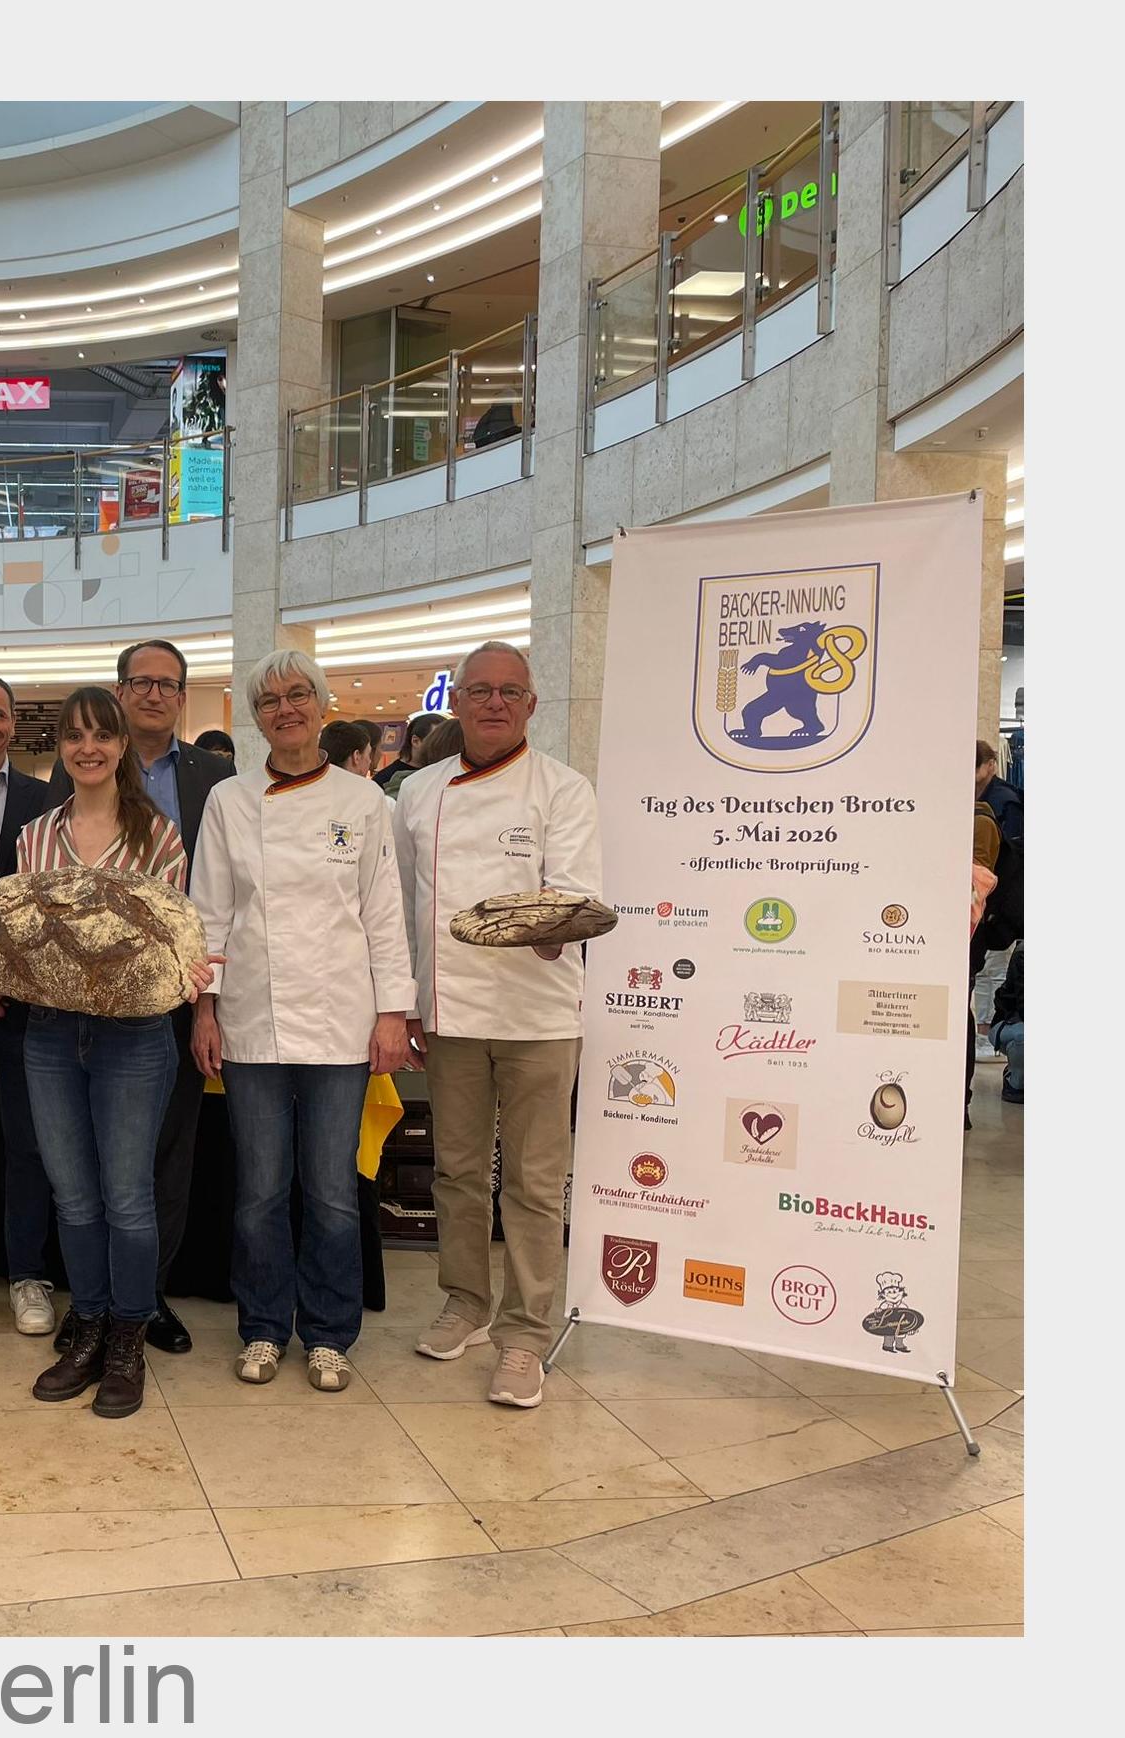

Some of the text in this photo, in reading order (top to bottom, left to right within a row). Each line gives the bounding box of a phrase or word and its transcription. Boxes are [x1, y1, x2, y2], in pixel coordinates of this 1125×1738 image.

[188, 466, 222, 475] German
[720, 585, 846, 619] BÄCKER-INNUNG
[718, 620, 772, 647] BERLIN
[641, 794, 916, 817] Tag des Deutschen Brotes
[713, 821, 838, 846] 5. Mai 2026
[689, 857, 763, 872] öffentliche
[766, 857, 860, 874] Brotprüfung
[614, 904, 708, 918] beumer lutum
[658, 919, 708, 928] gut gebacken
[732, 946, 806, 956] www.johann-mayer.de
[885, 947, 920, 956] BÄCKEREI
[606, 992, 683, 1010] SIEBERT
[608, 1008, 678, 1018] Bäckerei Konditorei
[716, 1024, 816, 1051] Kädtler
[606, 1050, 680, 1075] ZIMMERMANN
[875, 1070, 903, 1086] Café
[604, 1110, 634, 1121] Bäckerei
[641, 1114, 678, 1126] Konditorei
[858, 1122, 922, 1146] Obergfell
[592, 1184, 706, 1210] Dresdner Feinbäckerei
[618, 1200, 670, 1214] FRIEDRICHSHAGEN
[670, 1208, 682, 1216] SEIT
[779, 1192, 936, 1230] BioBackHaus.
[606, 1244, 652, 1284] R
[612, 1279, 646, 1295] Rösler
[782, 1280, 828, 1298] BROT
[786, 1294, 822, 1311] GUT
